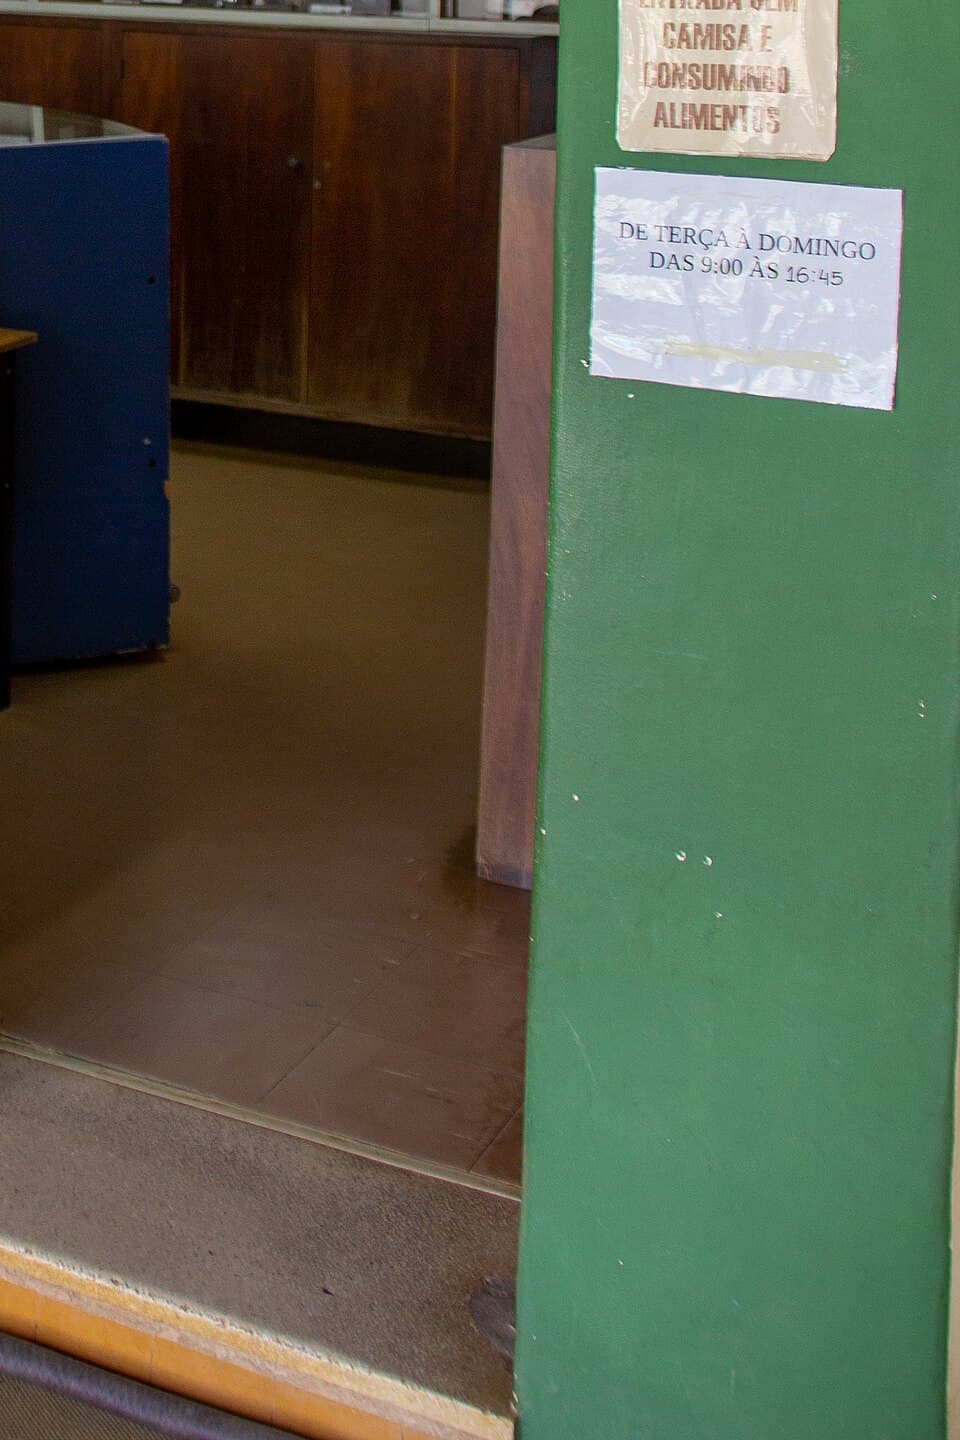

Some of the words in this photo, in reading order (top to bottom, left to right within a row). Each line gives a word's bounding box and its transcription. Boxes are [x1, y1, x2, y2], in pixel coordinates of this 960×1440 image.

[662, 21, 752, 51] CAMISA
[759, 24, 773, 52] E
[643, 61, 791, 94] CONSUMINDO
[652, 101, 781, 134] ALIMENTOS
[618, 221, 649, 242] DE
[654, 224, 730, 251] TERÇA
[735, 227, 752, 250] À
[758, 232, 877, 261] DOMINGO
[649, 251, 696, 273] DAS
[700, 256, 744, 277] 9:00
[749, 255, 780, 279] ÀS
[785, 266, 844, 287] 16:45
